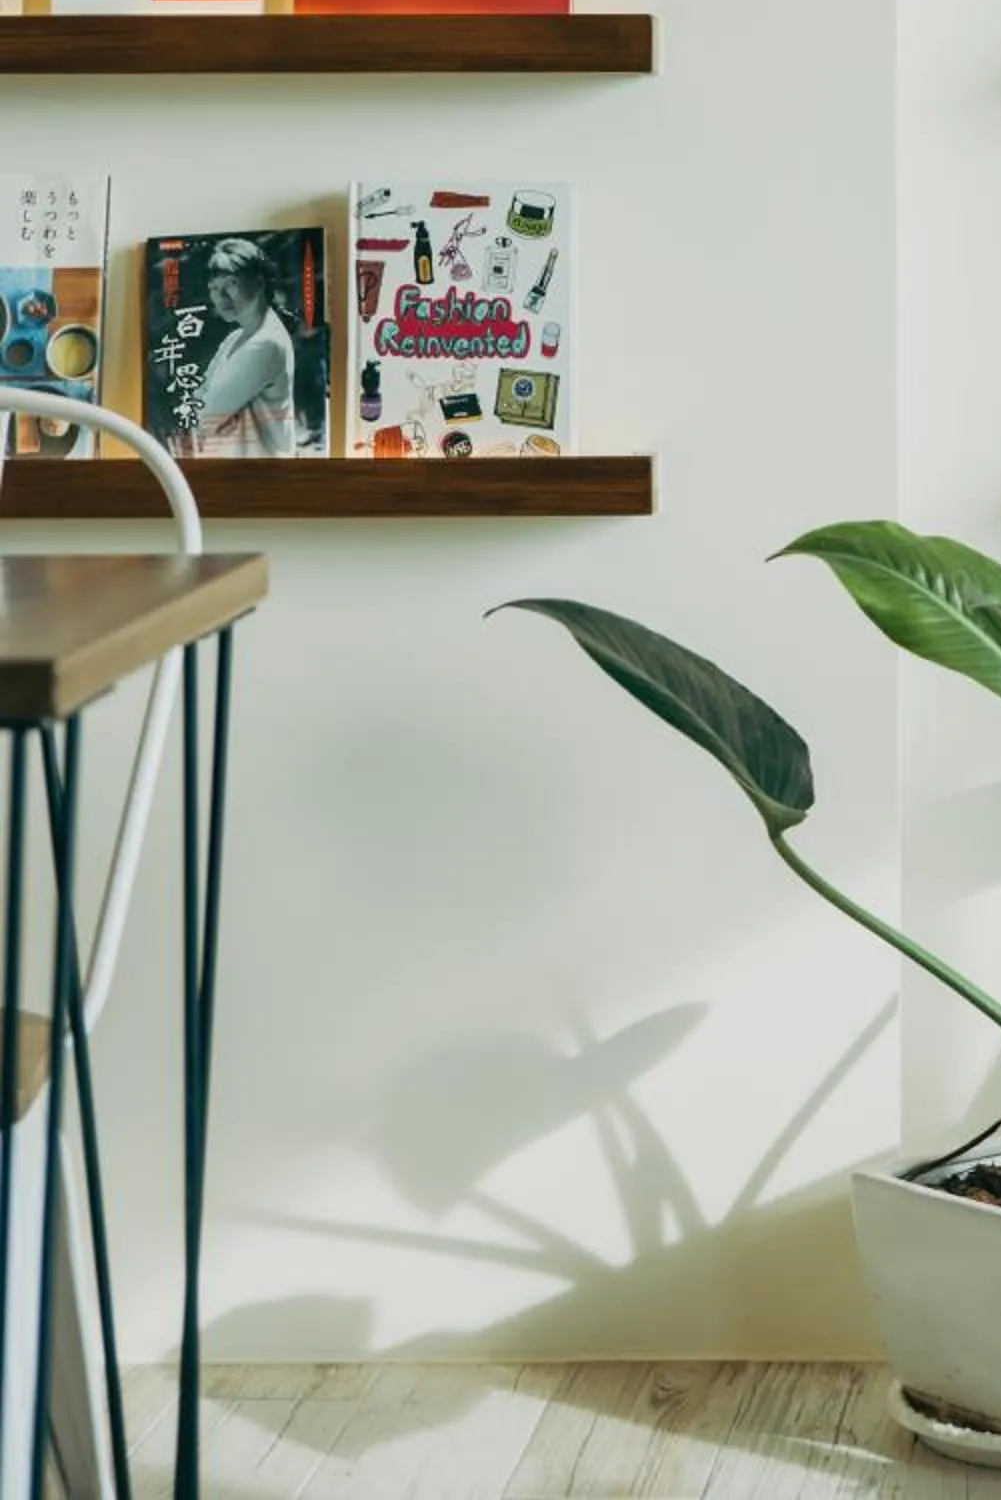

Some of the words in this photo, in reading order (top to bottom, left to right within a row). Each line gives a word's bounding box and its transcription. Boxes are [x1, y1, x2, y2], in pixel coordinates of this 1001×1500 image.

[394, 284, 512, 326] Fashion
[376, 319, 530, 359] Reinvented
[154, 305, 207, 429] 百年思索
